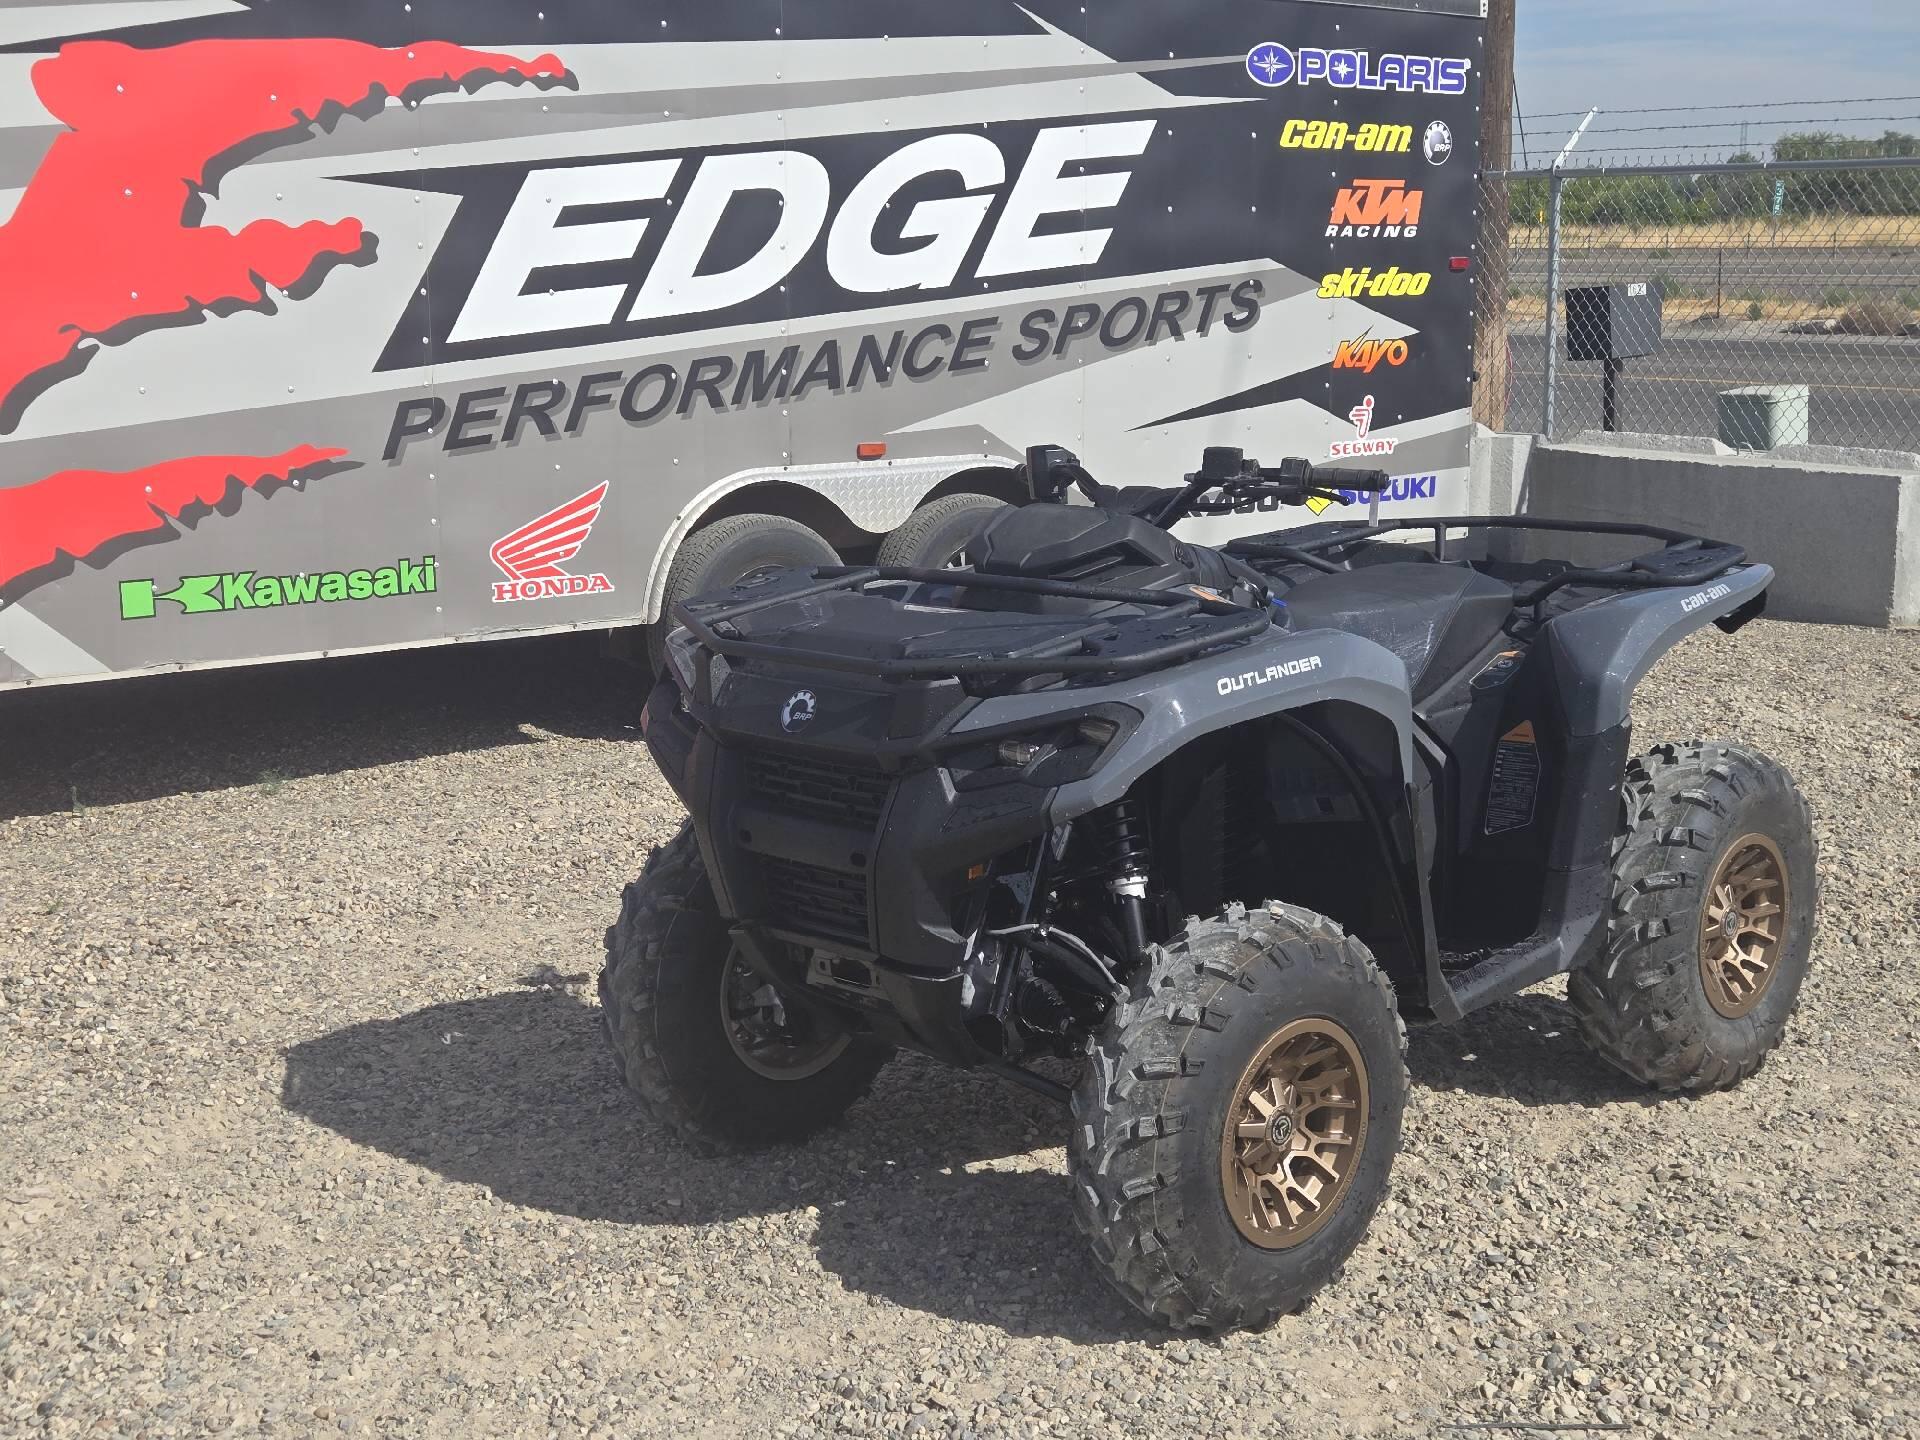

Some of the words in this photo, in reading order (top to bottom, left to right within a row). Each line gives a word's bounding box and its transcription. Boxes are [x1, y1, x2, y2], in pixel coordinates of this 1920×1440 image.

[1298, 47, 1467, 94] POLARIS
[1279, 119, 1413, 152] can-am
[1434, 144, 1450, 152] BRP
[1329, 179, 1424, 225] KTM
[445, 119, 1158, 344] EDGE
[1324, 225, 1418, 238] RACING
[1317, 266, 1432, 298] ski-doo
[1332, 325, 1409, 374] KAYO
[381, 315, 1000, 464] PERFORMANCE
[1011, 279, 1264, 365] SPORTS
[1331, 440, 1396, 456] SEGWAY
[221, 554, 437, 610] Kawasaki
[492, 574, 615, 602] HONDA
[1680, 583, 1732, 612] can-am
[1216, 655, 1323, 696] OUTLANDER
[792, 711, 813, 721] BRP
